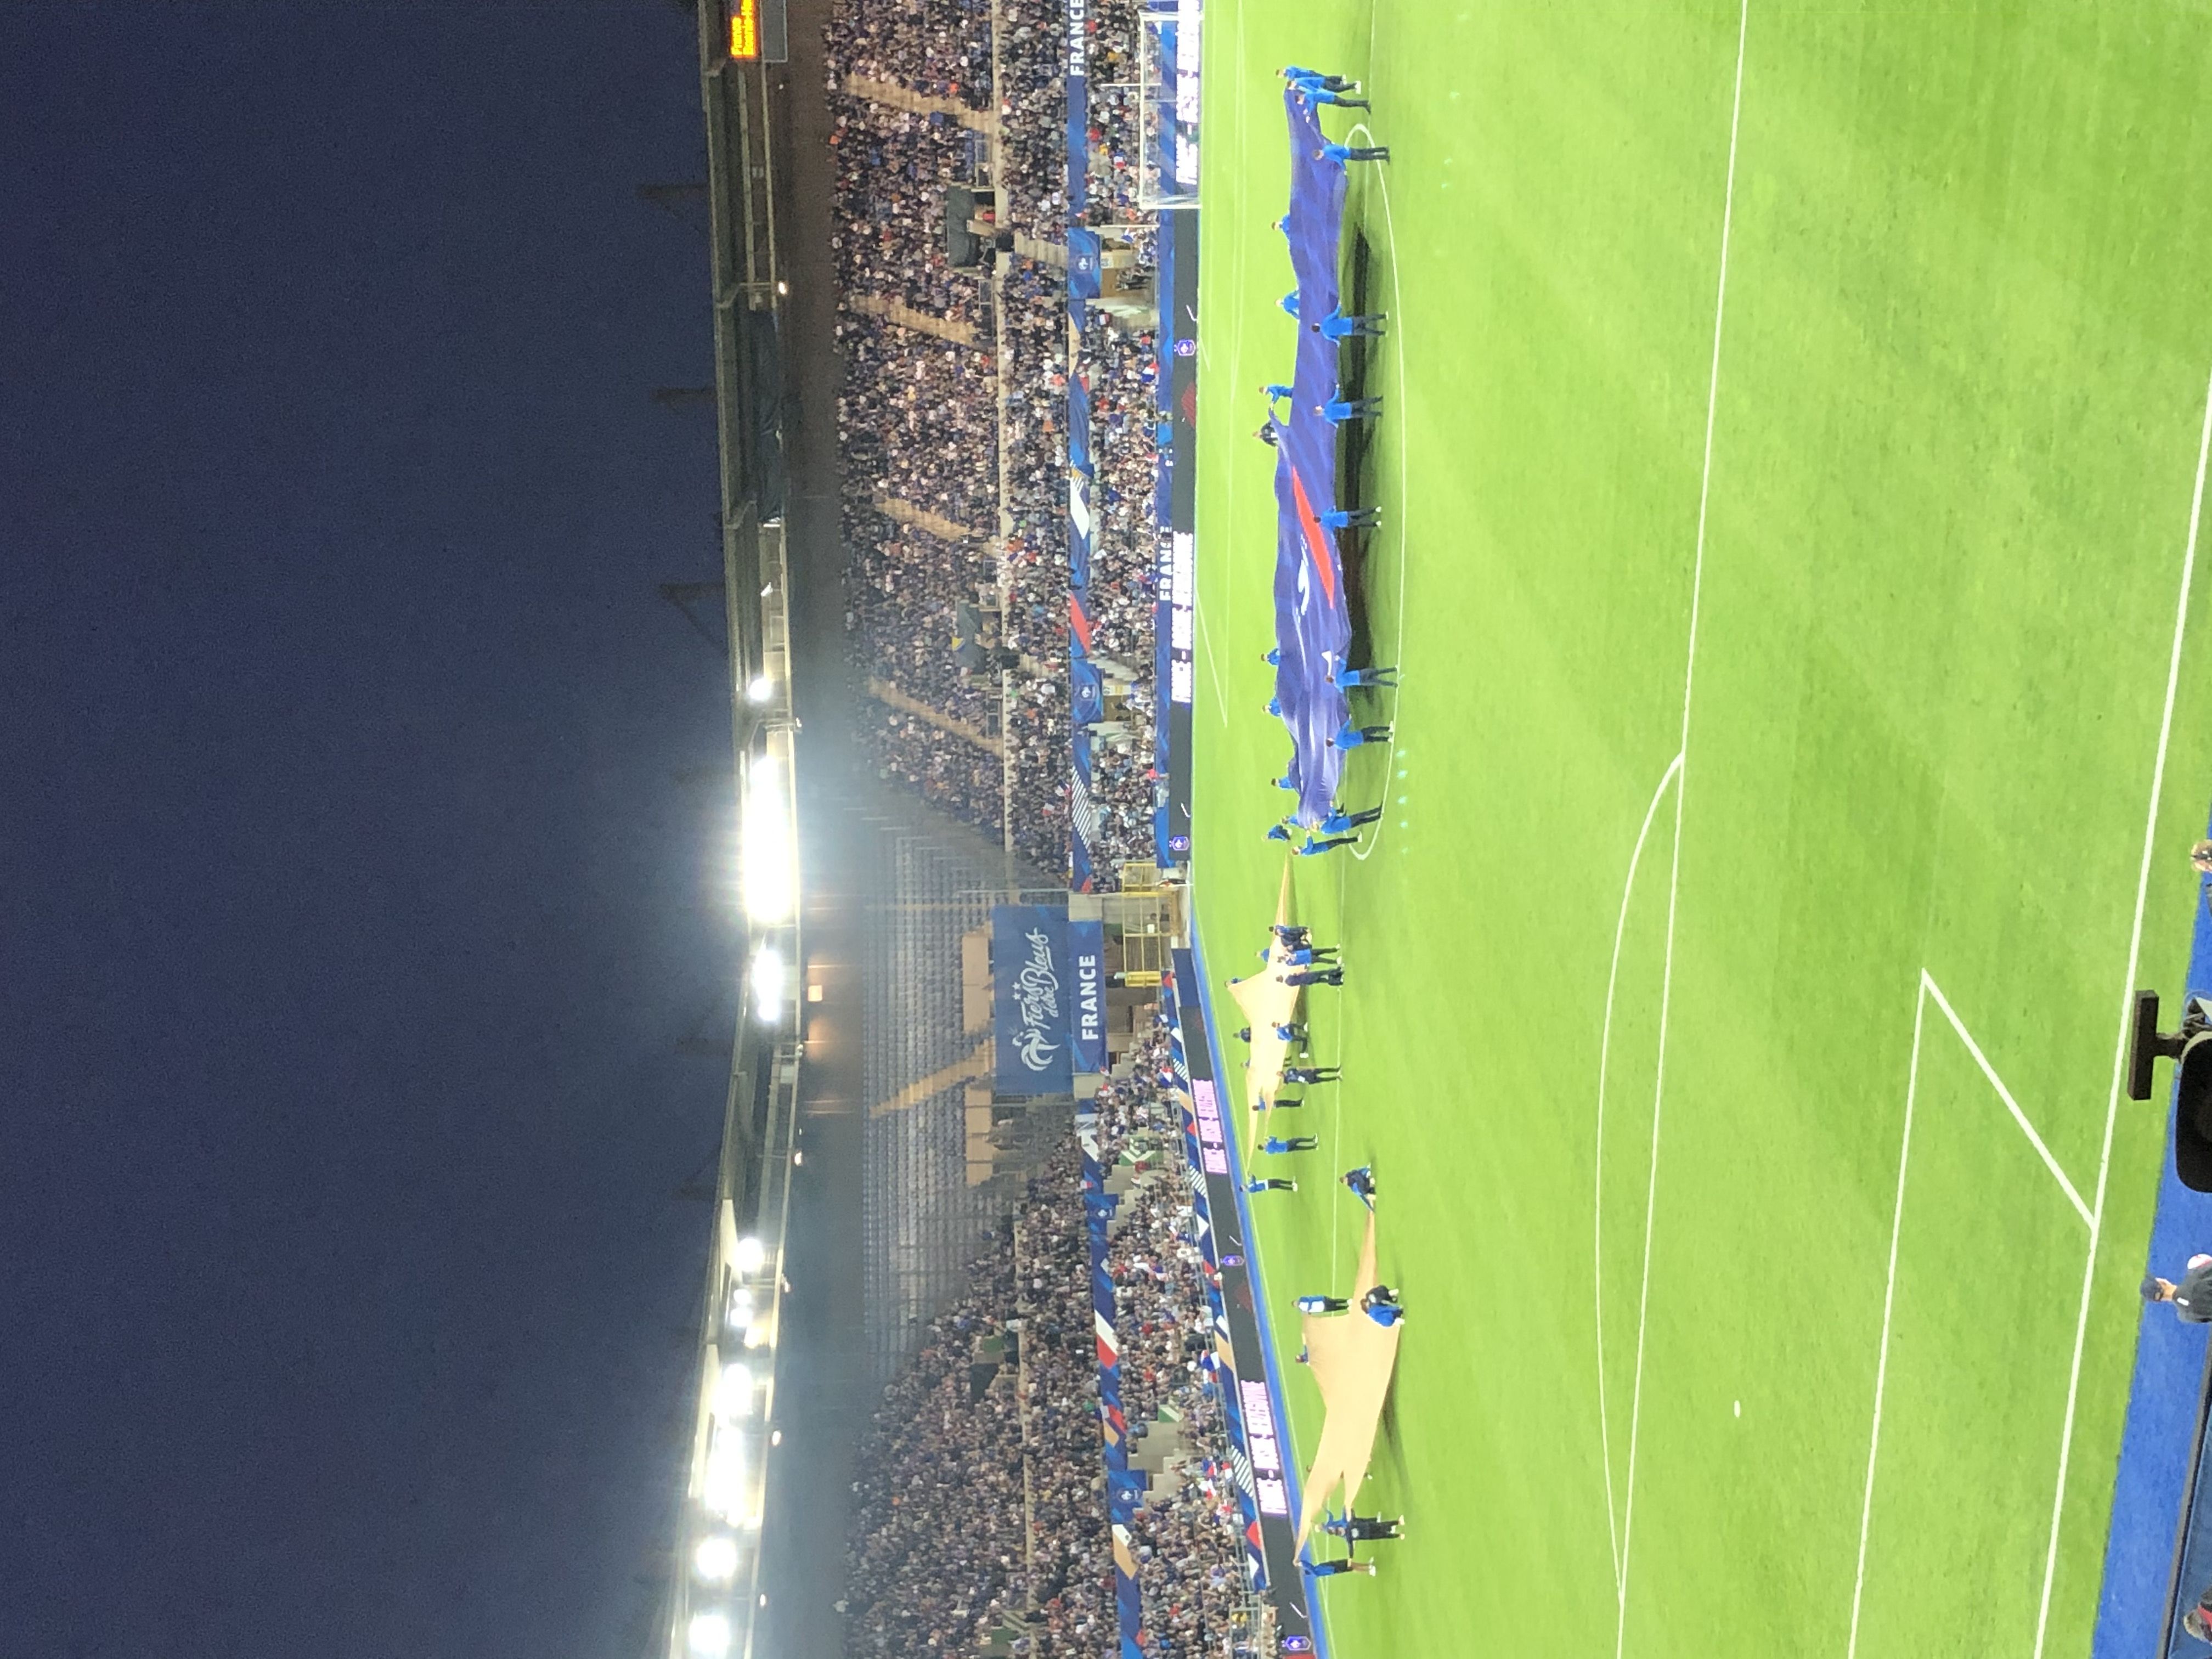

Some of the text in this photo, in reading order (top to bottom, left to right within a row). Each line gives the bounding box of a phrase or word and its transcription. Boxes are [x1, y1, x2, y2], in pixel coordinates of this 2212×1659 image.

[1069, 0, 1085, 76] FRANCE
[1020, 927, 1059, 991] Bleus
[1021, 985, 1051, 1030] Fiers
[1079, 955, 1099, 1040] FRANCE
